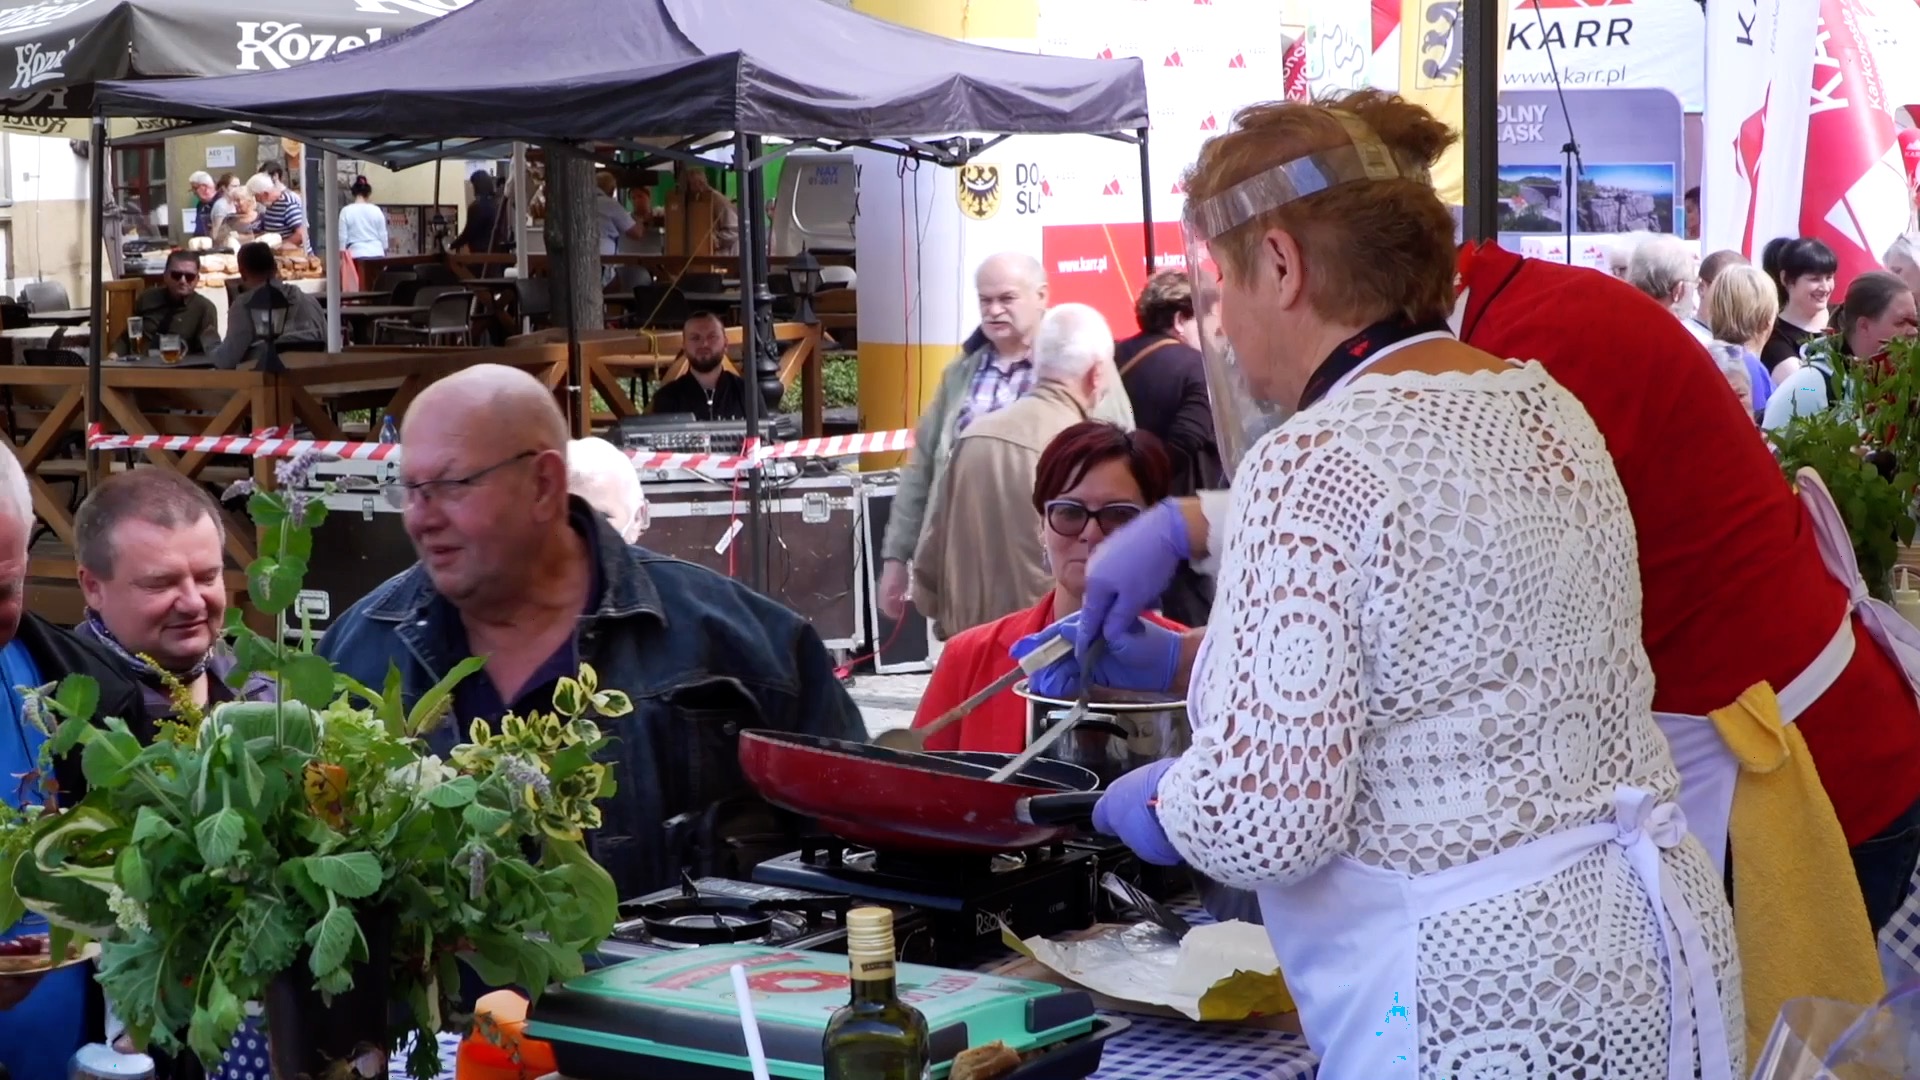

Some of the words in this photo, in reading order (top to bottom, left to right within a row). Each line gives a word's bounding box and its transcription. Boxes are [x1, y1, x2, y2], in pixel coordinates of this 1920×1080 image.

[1507, 18, 1633, 50] KARR
[1503, 65, 1626, 86] www.karr.pl
[1809, 17, 1849, 115] KA
[1497, 123, 1544, 144] ĄSK
[1057, 255, 1108, 273] www.karr.pl
[976, 903, 1014, 936] RSOIC
